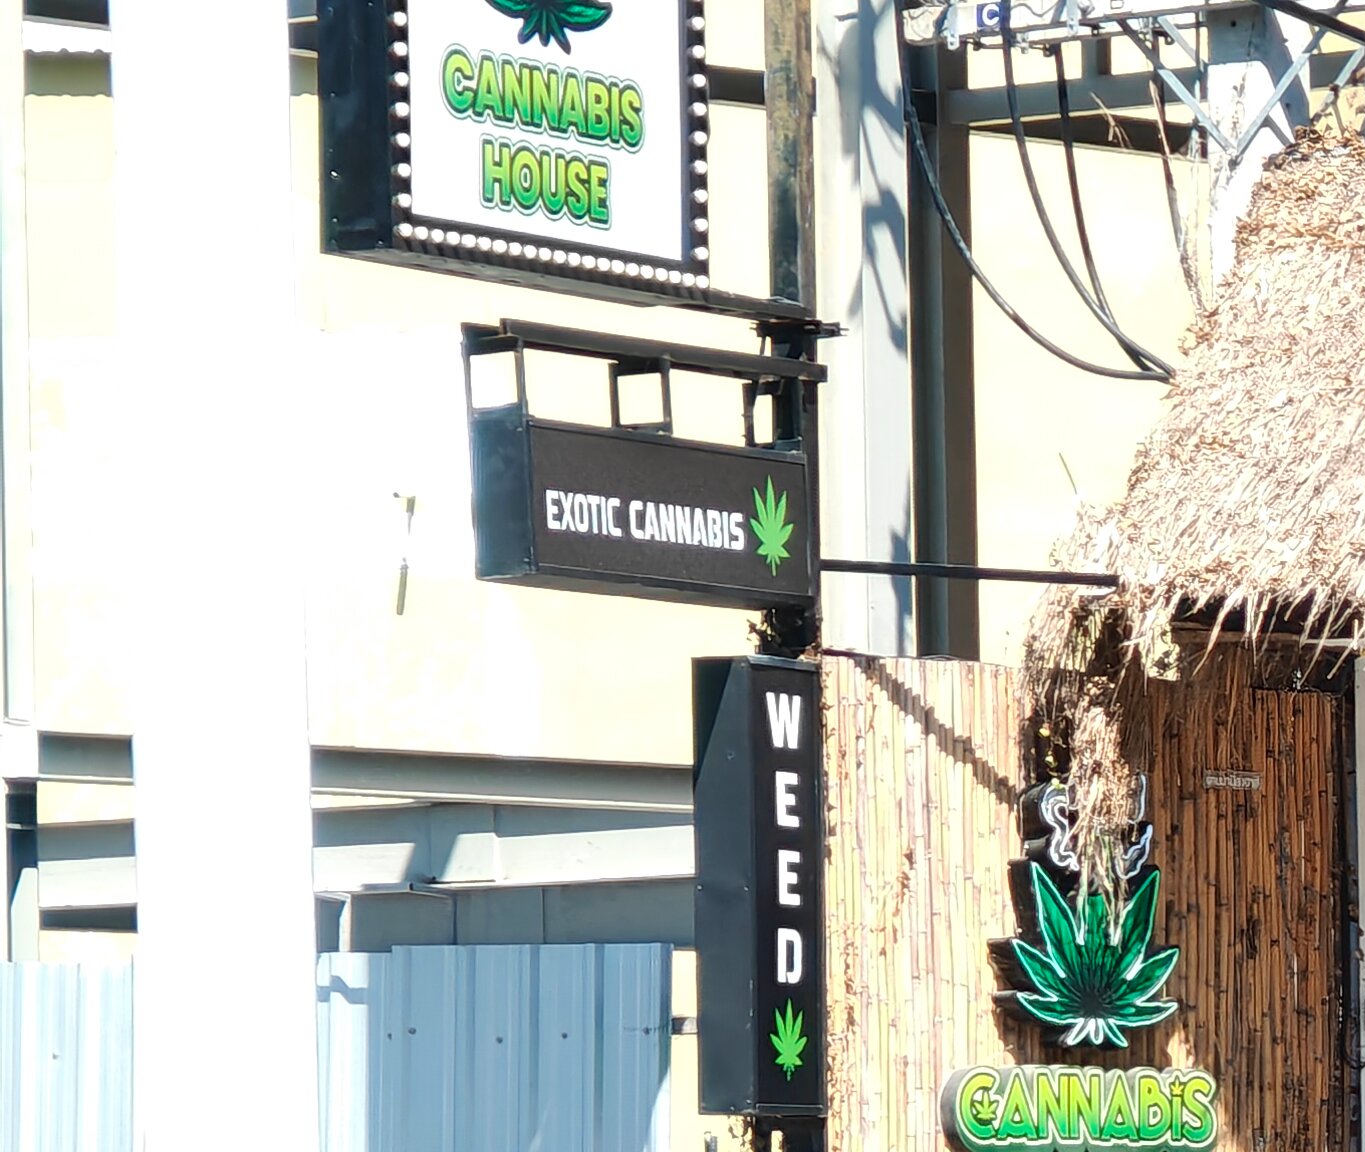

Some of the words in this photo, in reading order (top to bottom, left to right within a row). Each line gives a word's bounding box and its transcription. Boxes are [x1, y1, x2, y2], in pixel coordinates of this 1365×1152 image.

[442, 44, 645, 151] CANNABIS
[481, 139, 611, 229] HOUSE
[545, 488, 622, 537] EXOTIC
[629, 499, 745, 551] CANNABIS
[765, 690, 804, 987] WEED
